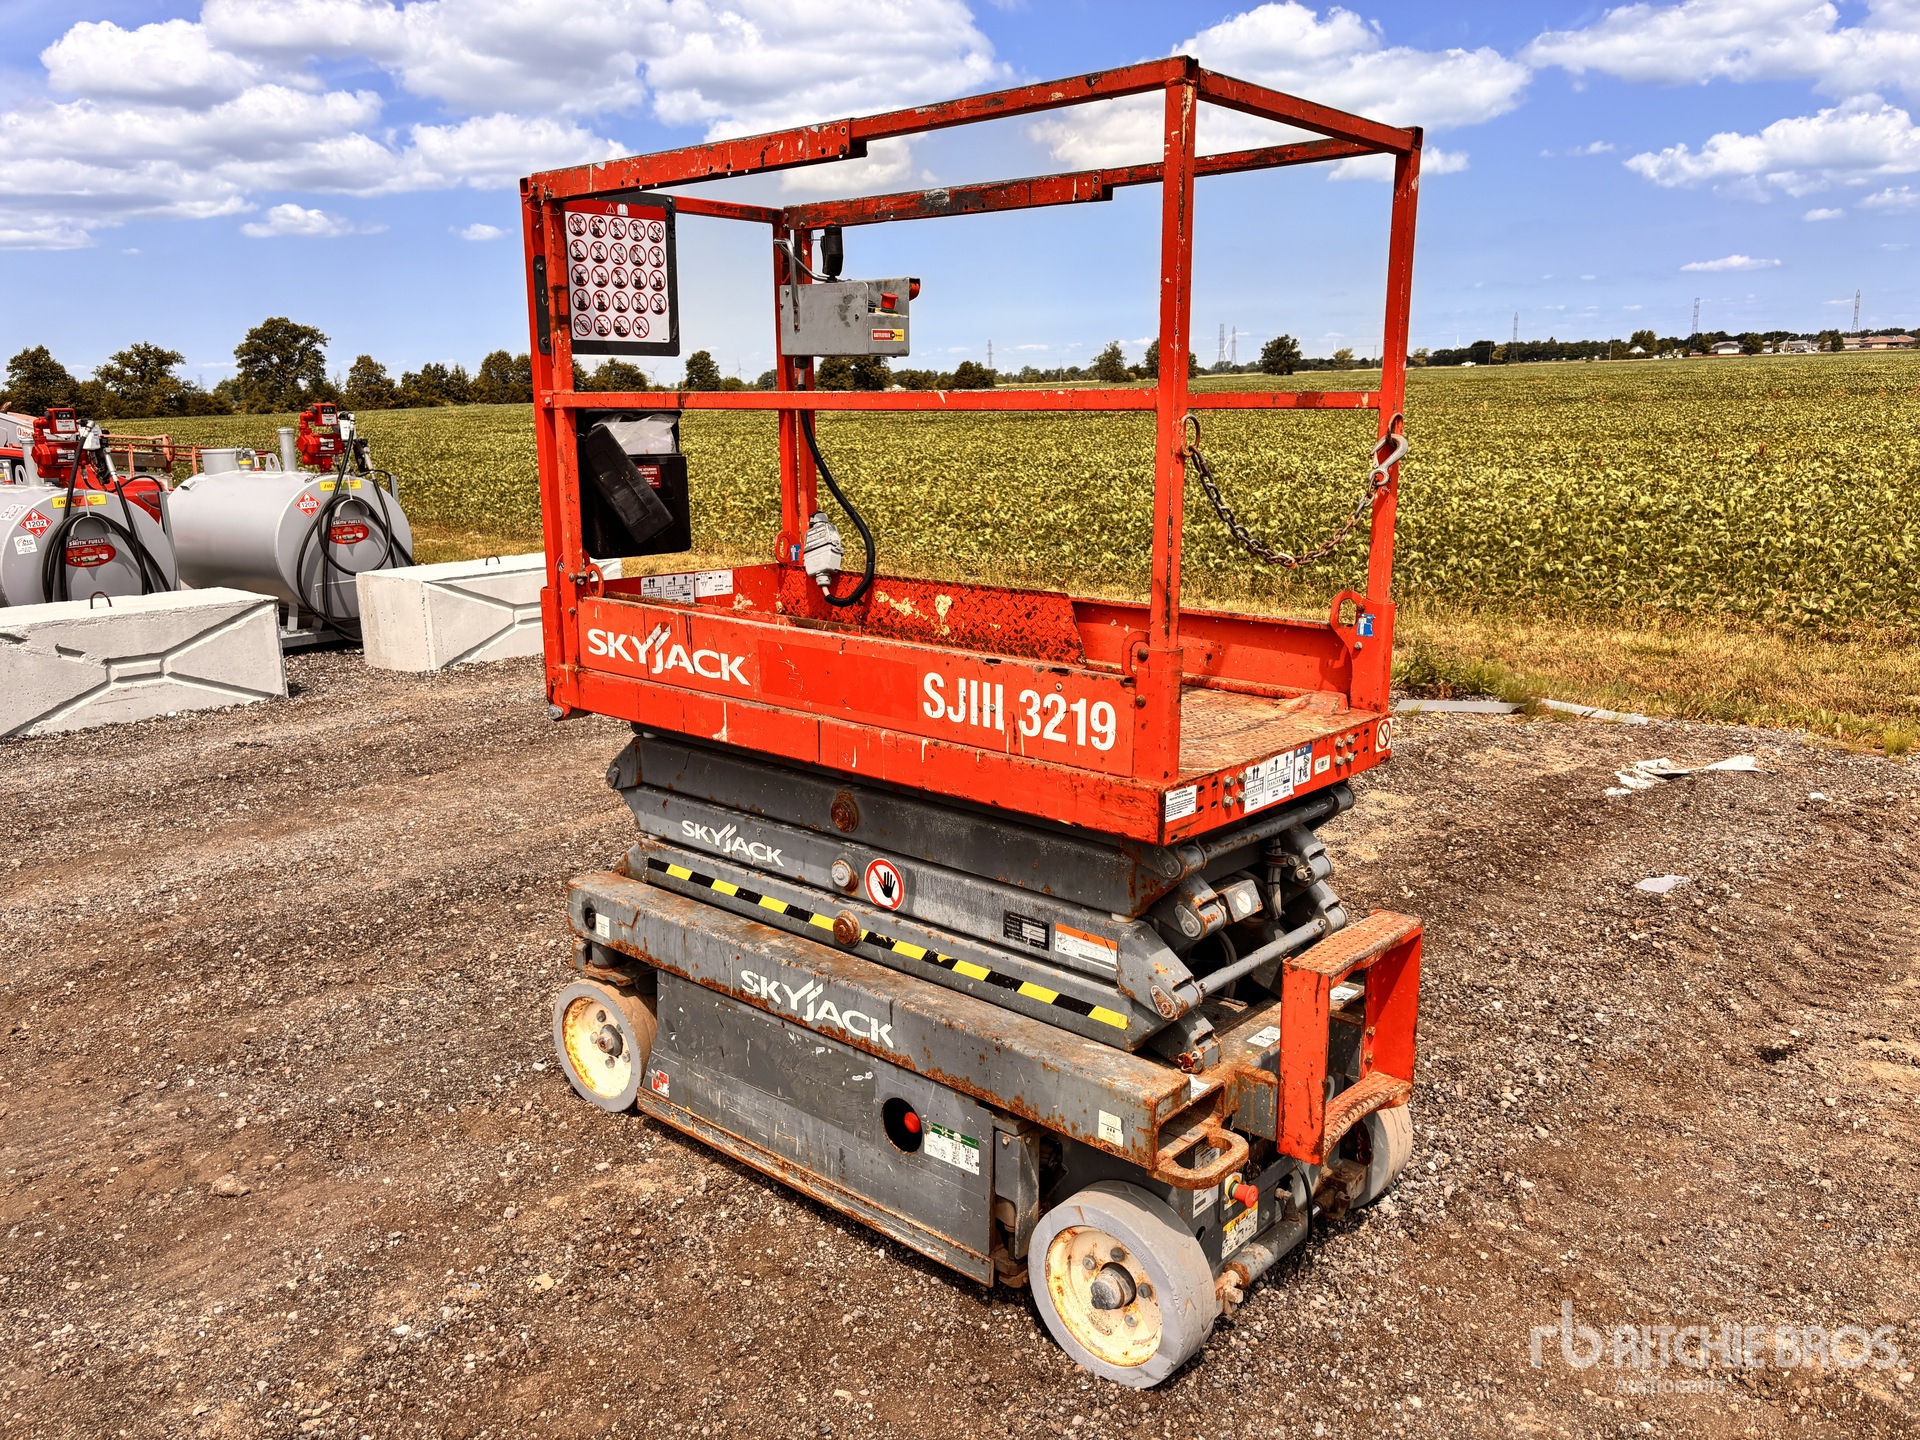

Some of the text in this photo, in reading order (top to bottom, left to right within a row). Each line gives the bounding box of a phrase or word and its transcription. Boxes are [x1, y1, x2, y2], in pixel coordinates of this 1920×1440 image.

[27, 520, 45, 528] 1202
[587, 621, 751, 686] SKYJACK
[922, 672, 1118, 751] SJIII 3219
[681, 819, 785, 868] SKYJACK
[739, 968, 895, 1049] SKYJACK
